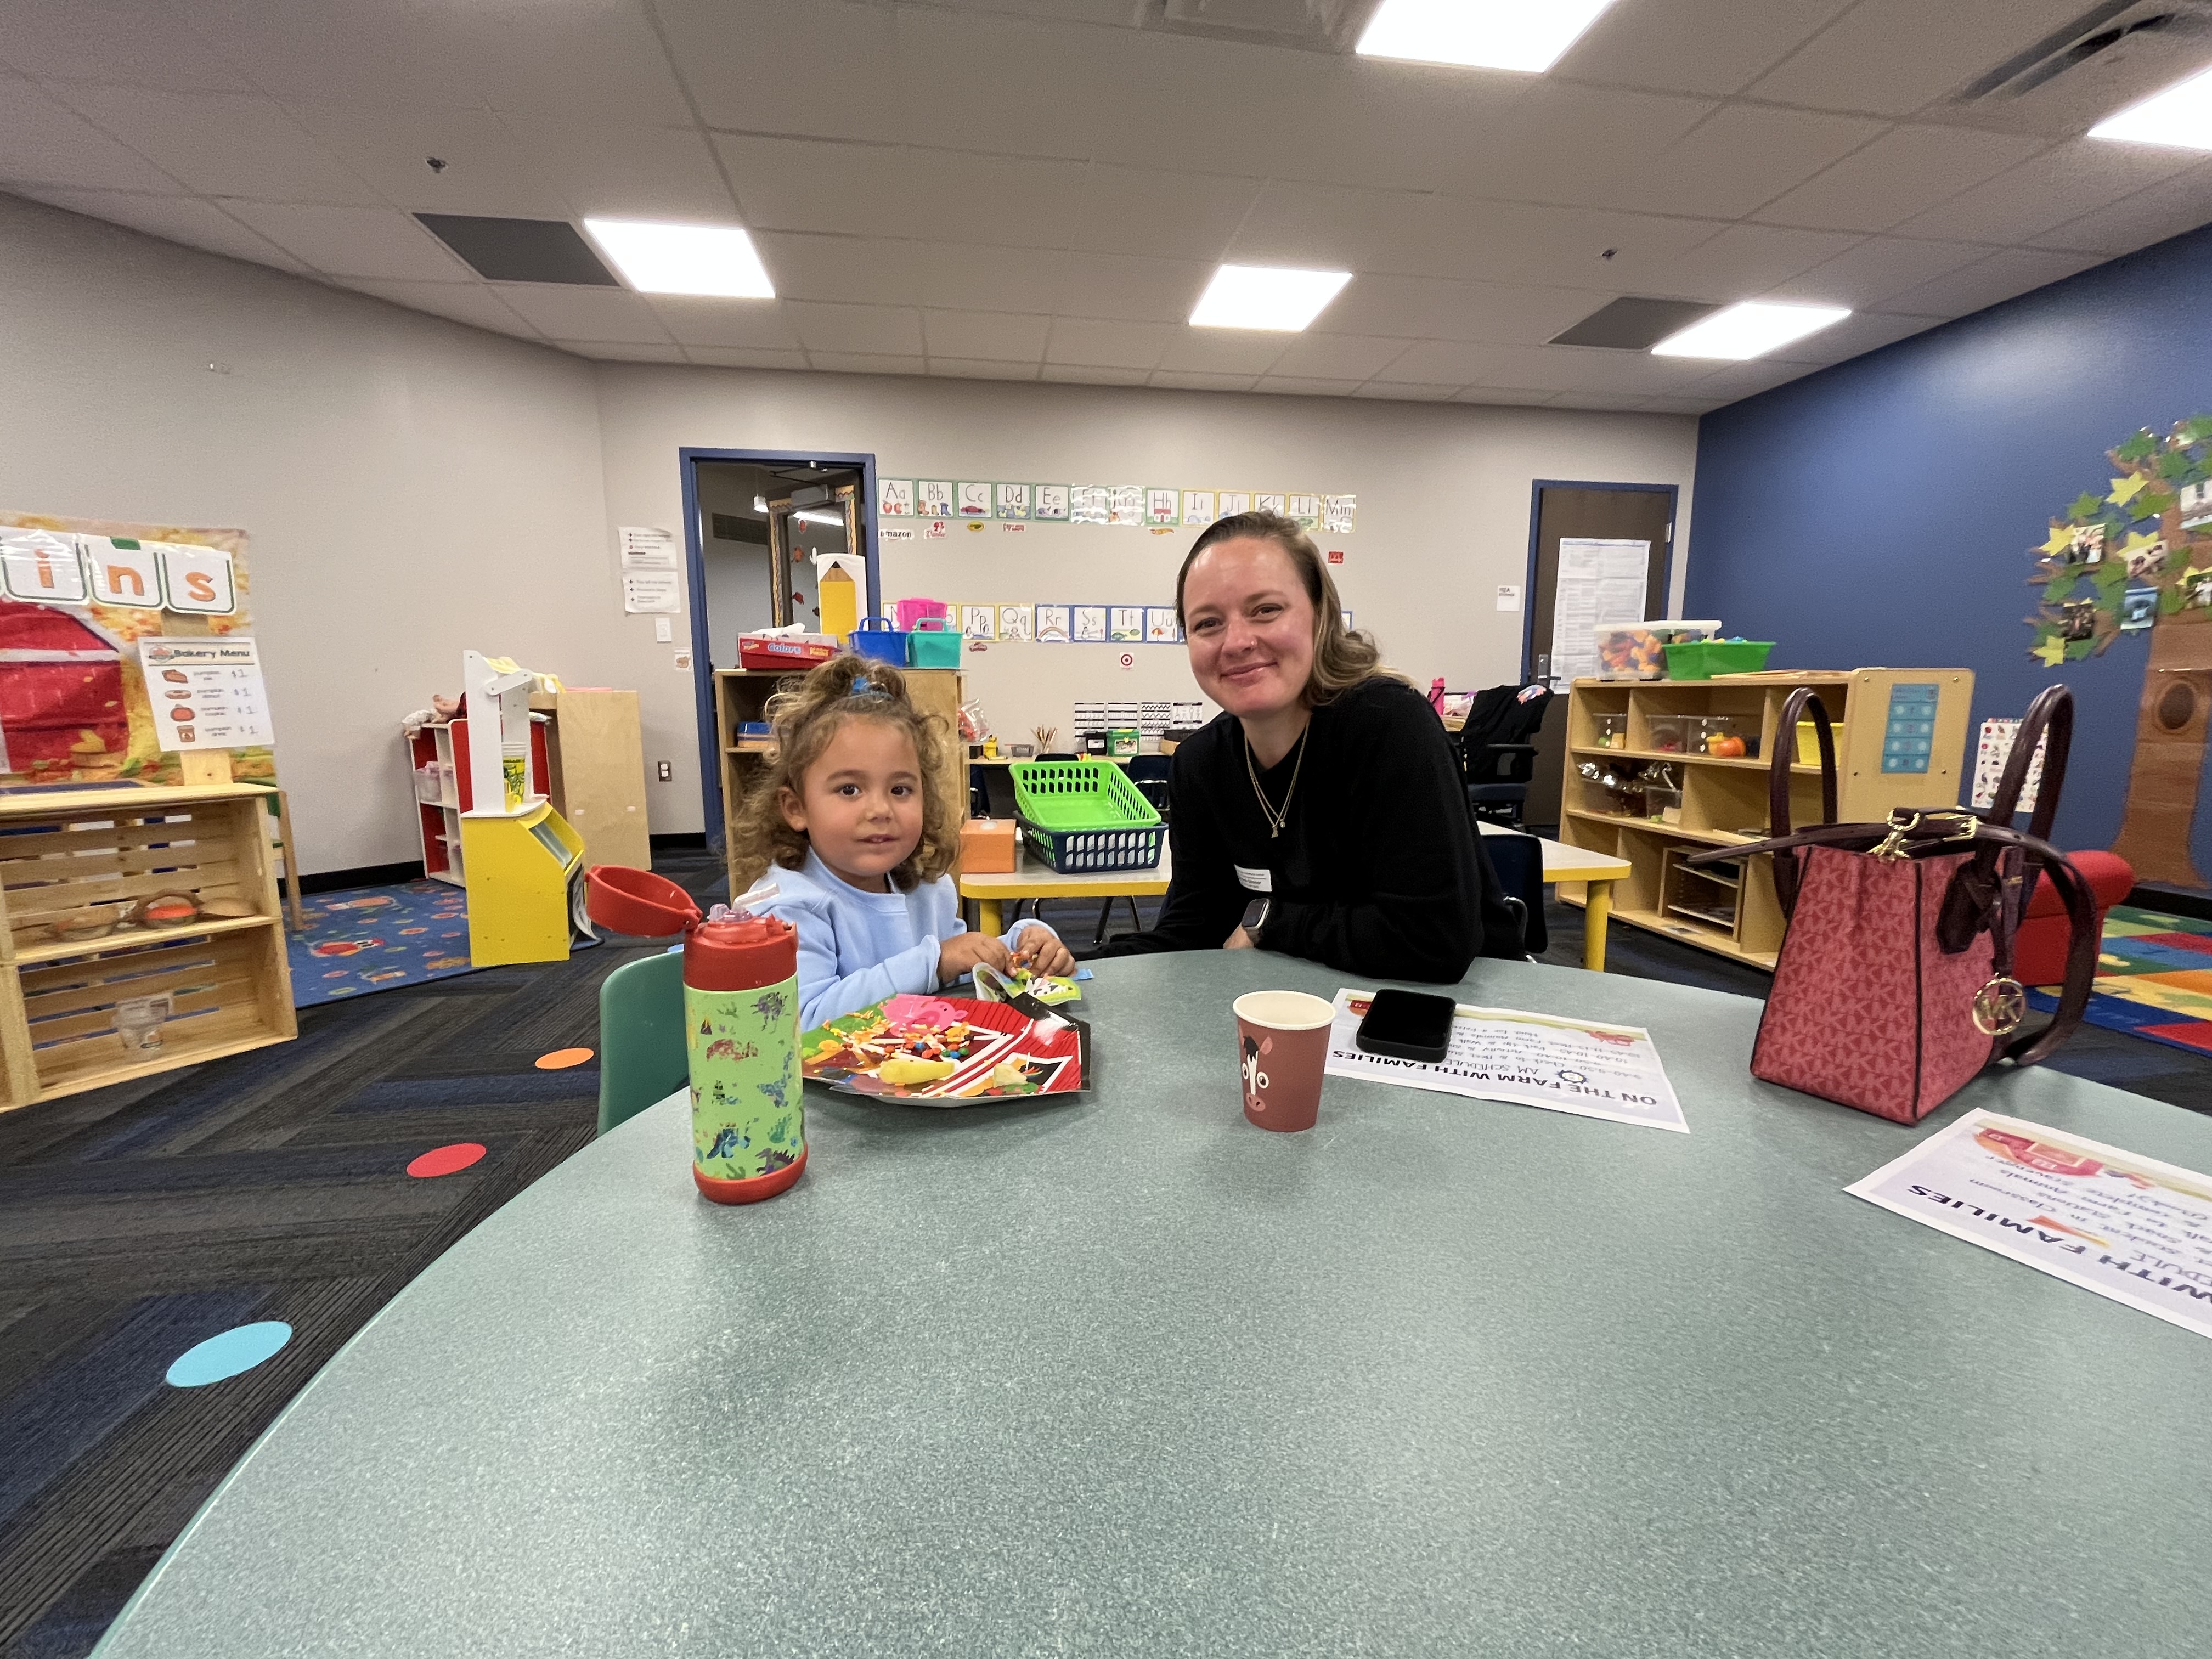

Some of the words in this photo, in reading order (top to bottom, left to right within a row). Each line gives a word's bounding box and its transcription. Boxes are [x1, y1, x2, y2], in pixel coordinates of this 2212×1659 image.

[885, 482, 906, 500] Aa
[927, 483, 944, 501] Bb
[964, 484, 984, 503] Cc
[1005, 486, 1023, 504] Dd
[1043, 487, 1062, 505] Ee
[1153, 492, 1172, 510] Hh
[1325, 499, 1351, 517] Mm
[970, 608, 990, 633] Pp
[1002, 608, 1031, 636] Qq
[1045, 610, 1062, 627] Rr
[1082, 610, 1097, 627] Ss
[1119, 610, 1134, 627] Tt
[174, 650, 216, 659] Bakery
[768, 642, 802, 654] Colors
[1332, 1050, 1427, 1070] FAMILIES
[1445, 1058, 1512, 1071] SCHEDULE
[1517, 1065, 1540, 1075] AM
[1435, 1065, 1490, 1080] WITH
[1497, 1074, 1561, 1088] FARM
[1568, 1084, 1616, 1099] THE
[1622, 1093, 1657, 1105] ON
[1985, 1155, 2075, 1186] Scavenger
[2000, 1169, 2068, 1194] Animals
[1969, 1178, 2057, 1212] Classroom
[2037, 1192, 2111, 1219] Stations
[1907, 1184, 2086, 1255] FAMILIES
[2097, 1255, 2212, 1302] WITH
